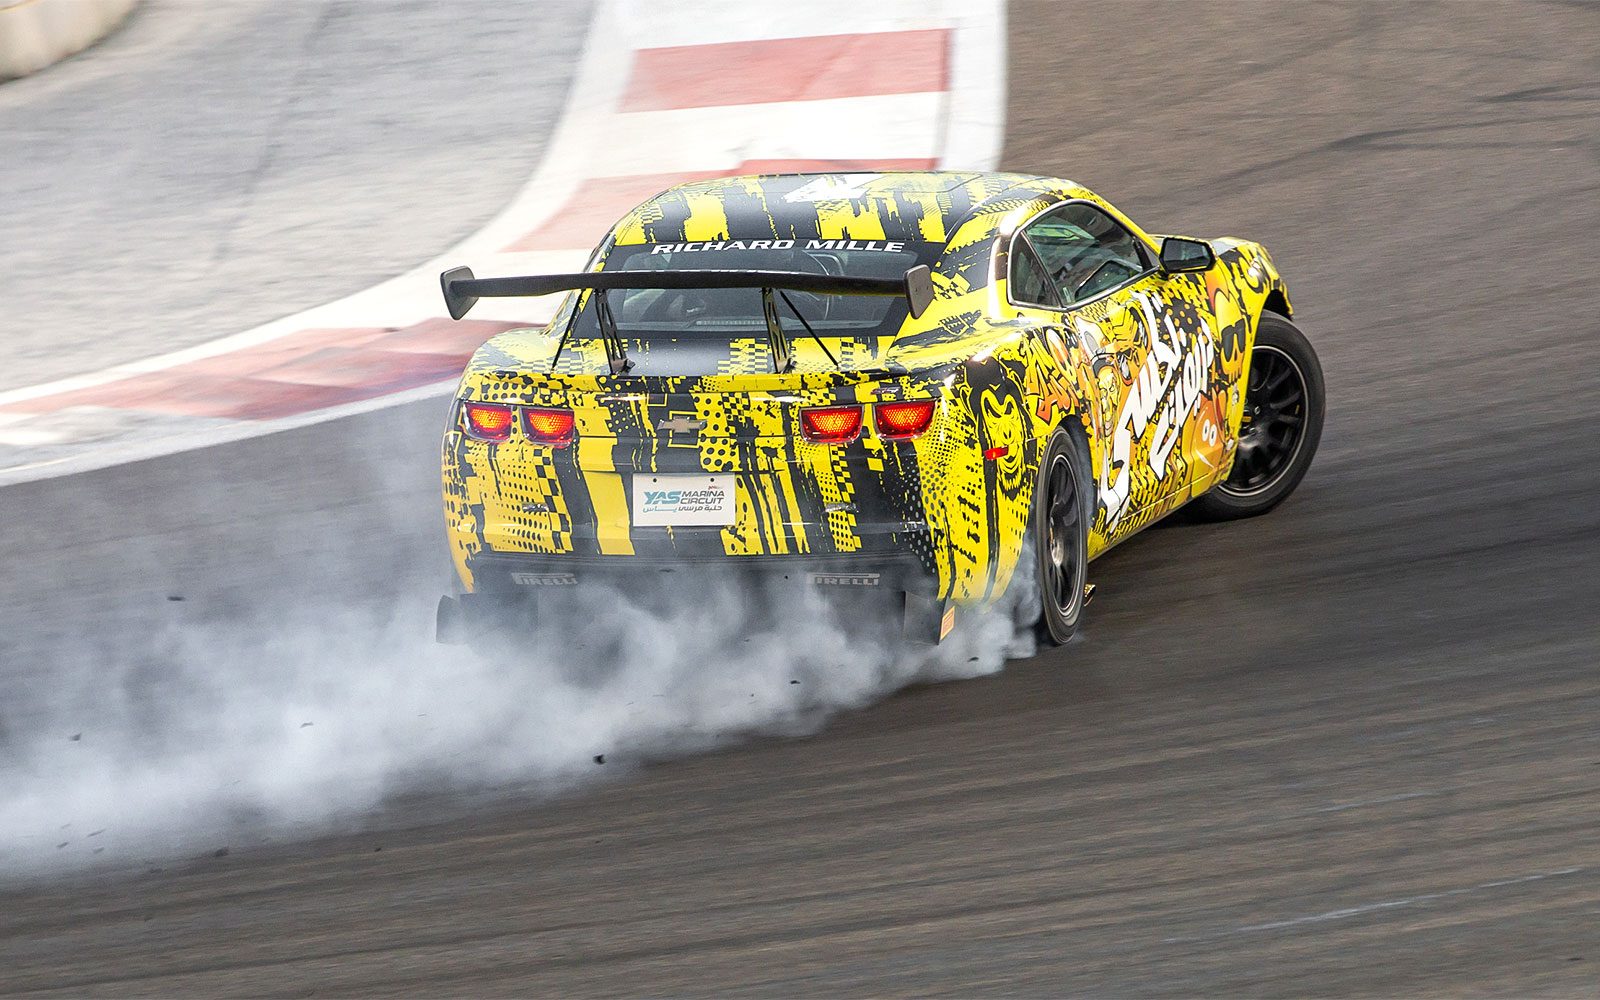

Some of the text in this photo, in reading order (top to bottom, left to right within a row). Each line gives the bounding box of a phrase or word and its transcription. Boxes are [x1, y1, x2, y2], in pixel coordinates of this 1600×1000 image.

[651, 240, 905, 254] RICHARD MILLE
[644, 491, 681, 504] YAS
[511, 572, 578, 585] PIRELLI
[805, 572, 881, 586] PIRELLI
